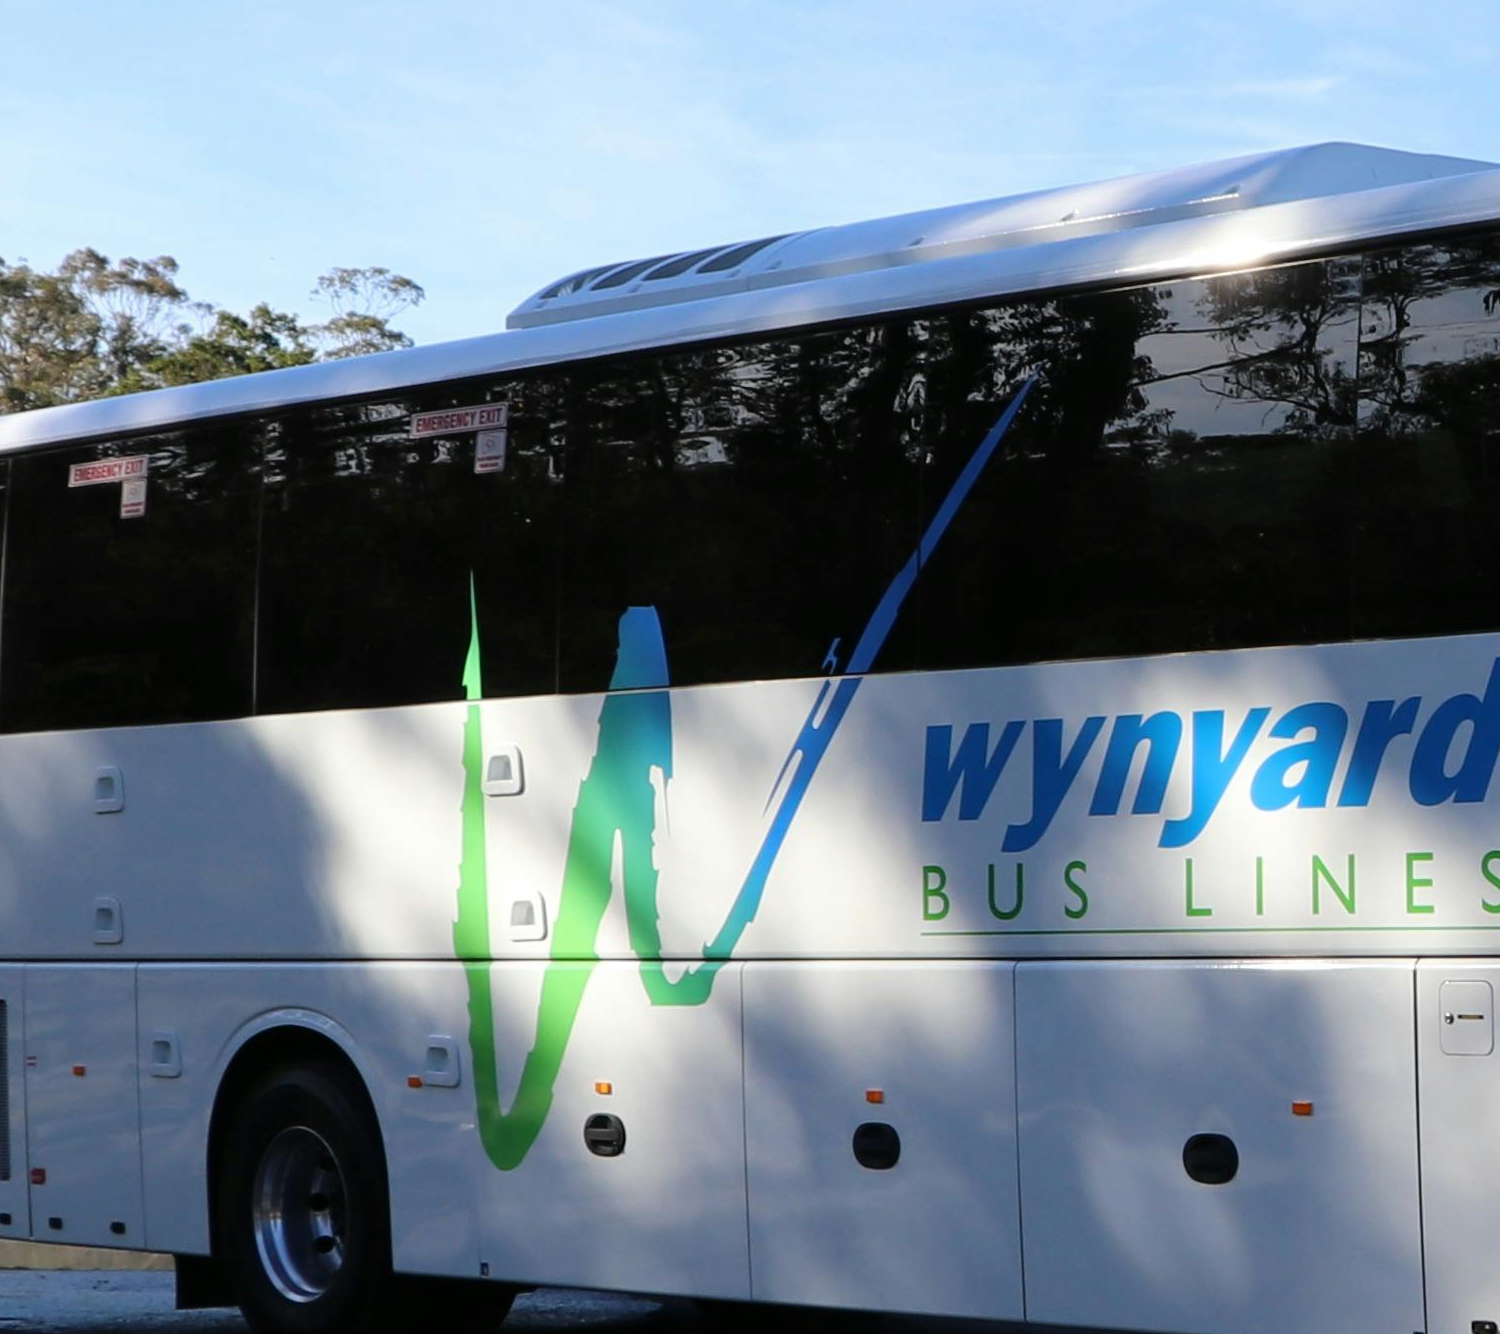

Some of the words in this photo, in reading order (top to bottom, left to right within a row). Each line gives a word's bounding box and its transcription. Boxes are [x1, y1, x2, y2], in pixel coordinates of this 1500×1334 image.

[416, 410, 477, 433] EMERGENCY
[479, 407, 503, 425] EXIT
[74, 462, 122, 482] EMERGENCY
[124, 459, 144, 475] EXIT
[922, 860, 1090, 921] BUS
